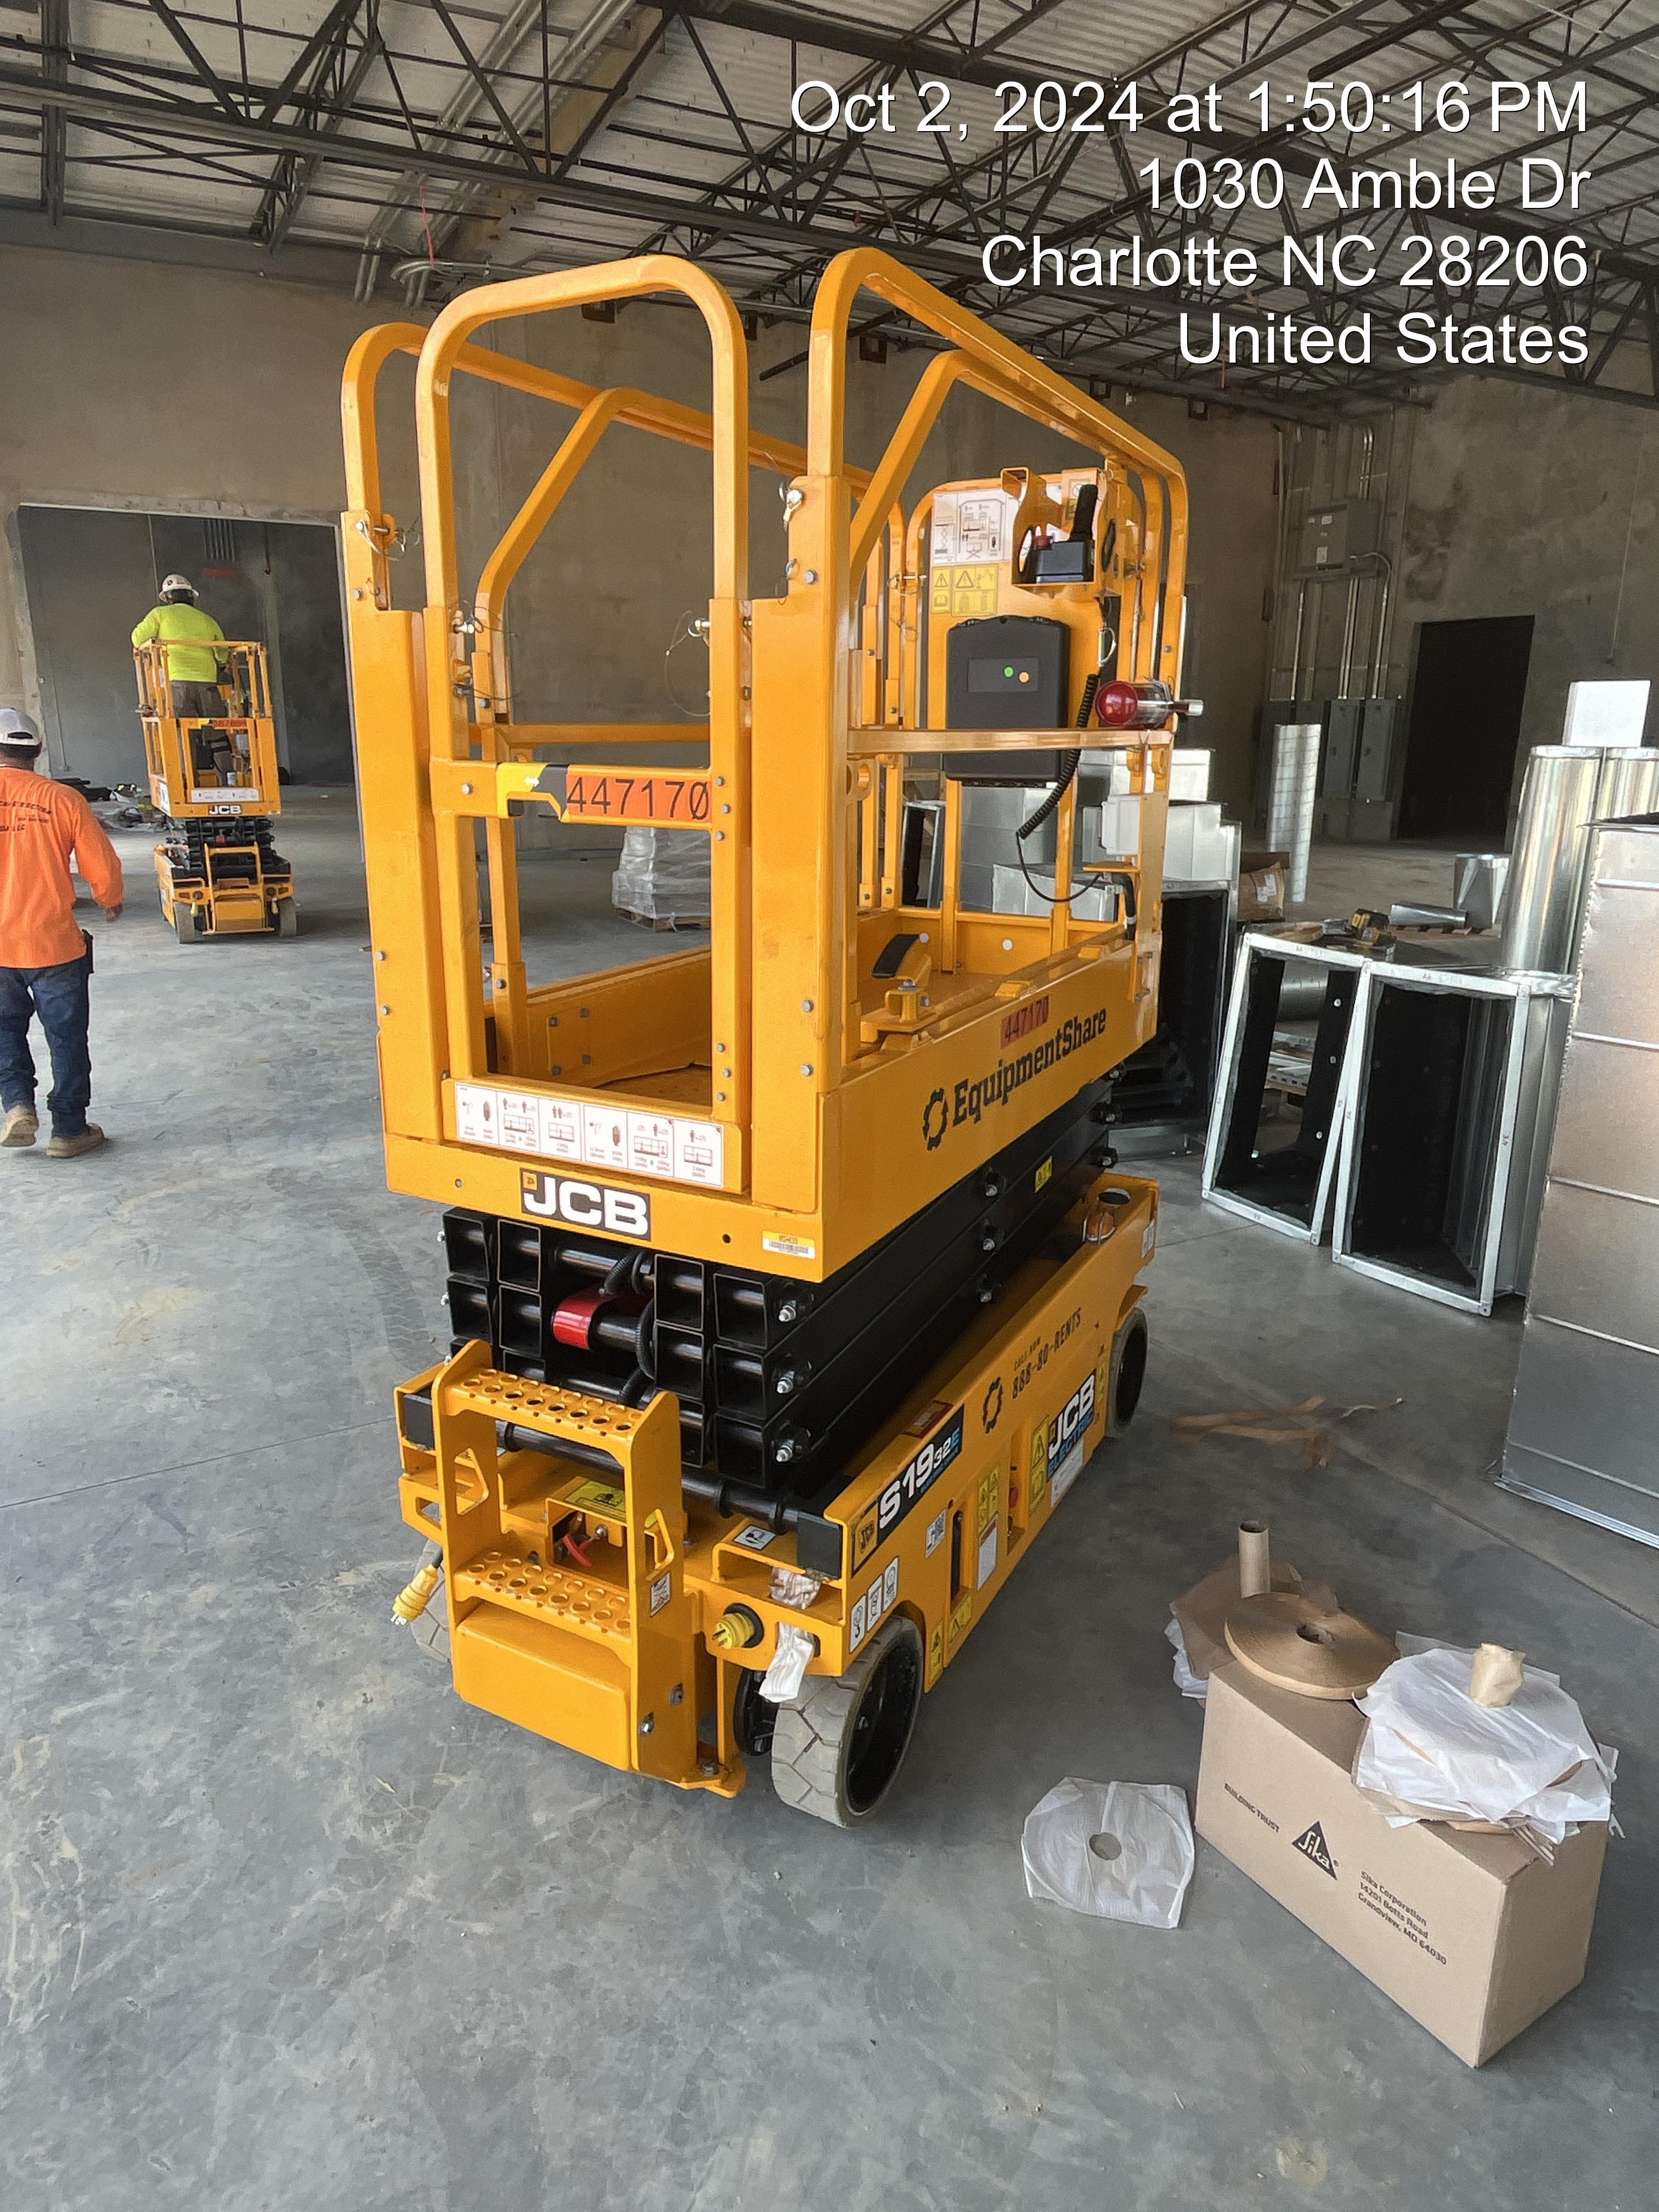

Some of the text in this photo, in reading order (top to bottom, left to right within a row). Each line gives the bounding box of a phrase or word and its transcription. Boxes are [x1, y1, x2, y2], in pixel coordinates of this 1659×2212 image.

[208, 805, 242, 815] JCB
[567, 776, 710, 821] 447170
[1005, 995, 1049, 1043] 447170
[952, 1008, 1107, 1127] EquipmentShare
[523, 1176, 648, 1236] JCB
[1048, 1374, 1095, 1460] JCB
[1224, 1782, 1280, 1833] BUILDING TRUST
[1297, 1830, 1331, 1870] Sika
[1359, 1881, 1429, 1940] 14201 Botts Road
[1361, 1870, 1427, 1927] Sika Corporation
[1358, 1892, 1402, 1932] Grandview,
[1419, 1939, 1447, 1966] 64030
